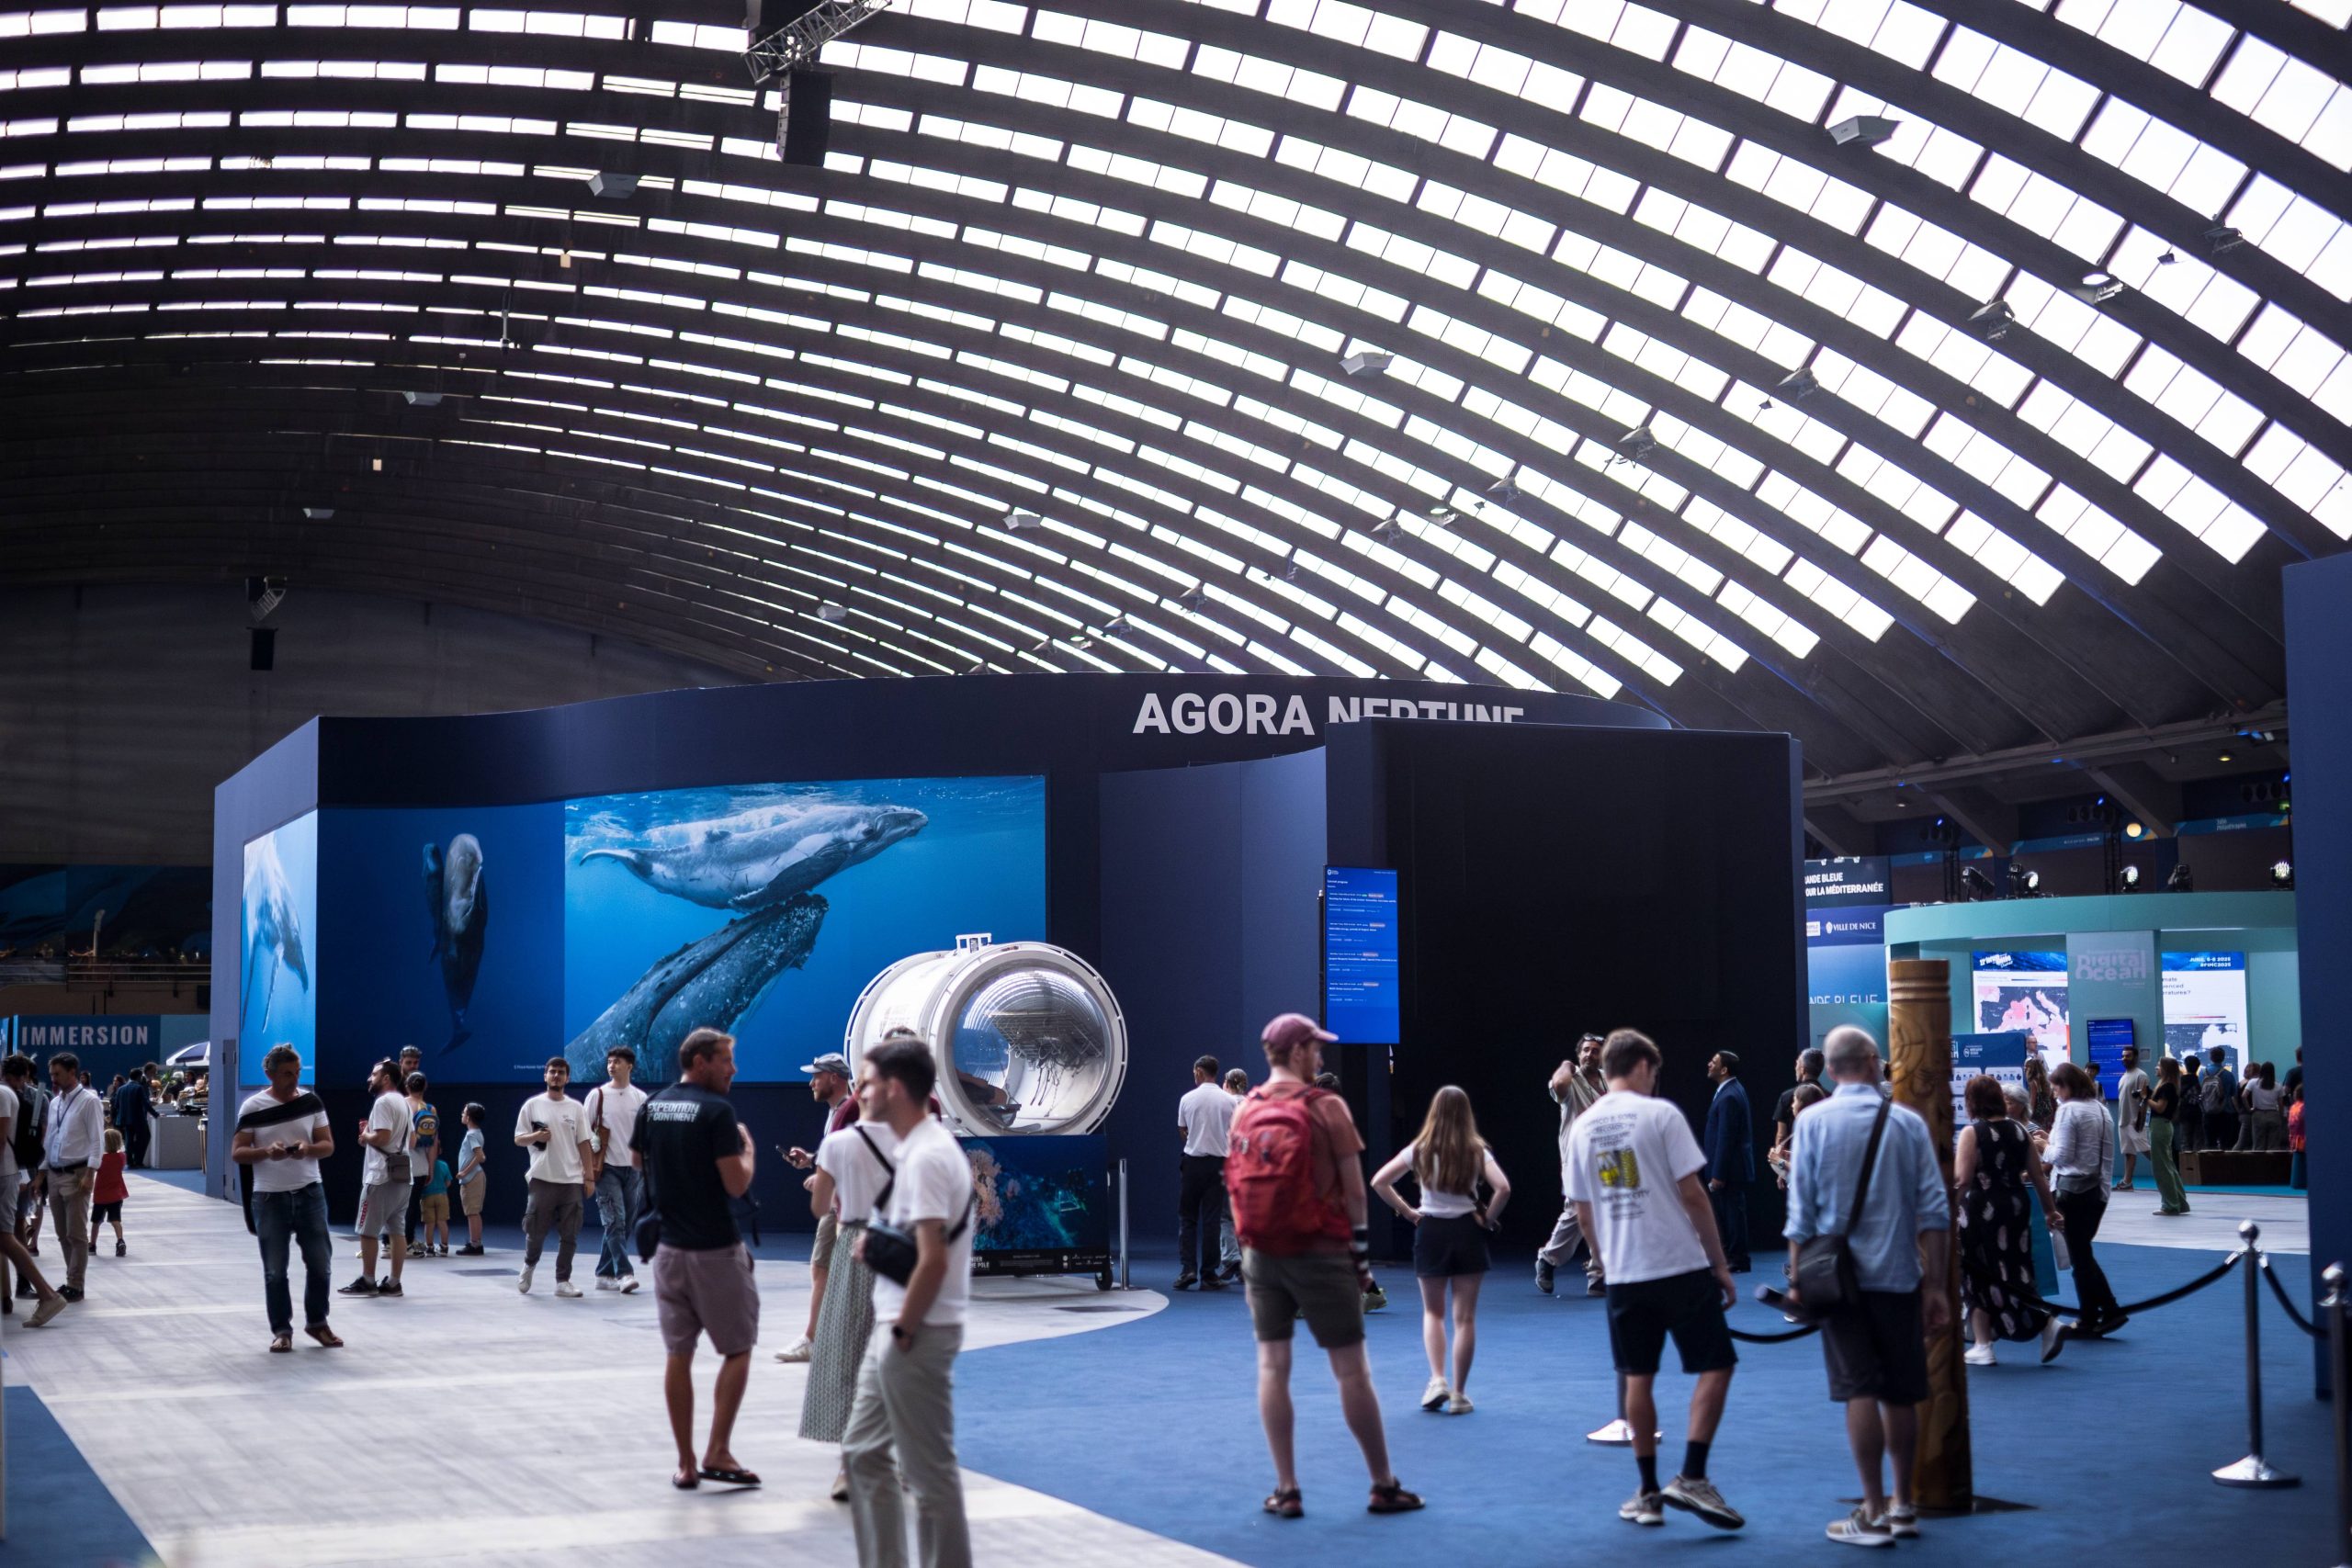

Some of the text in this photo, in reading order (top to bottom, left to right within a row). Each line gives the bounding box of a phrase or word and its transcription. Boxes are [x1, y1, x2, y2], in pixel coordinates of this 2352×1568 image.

[1132, 693, 1316, 736] AGORA
[1822, 872, 1843, 883] BLEUE
[1817, 886, 1826, 896] LA
[1826, 882, 1883, 895] MÉDITERRANÉE
[2075, 950, 2146, 967] Digital
[2075, 965, 2146, 981] Ocean
[21, 1026, 148, 1046] IMMERSION
[647, 1101, 700, 1114] EXPEDITION
